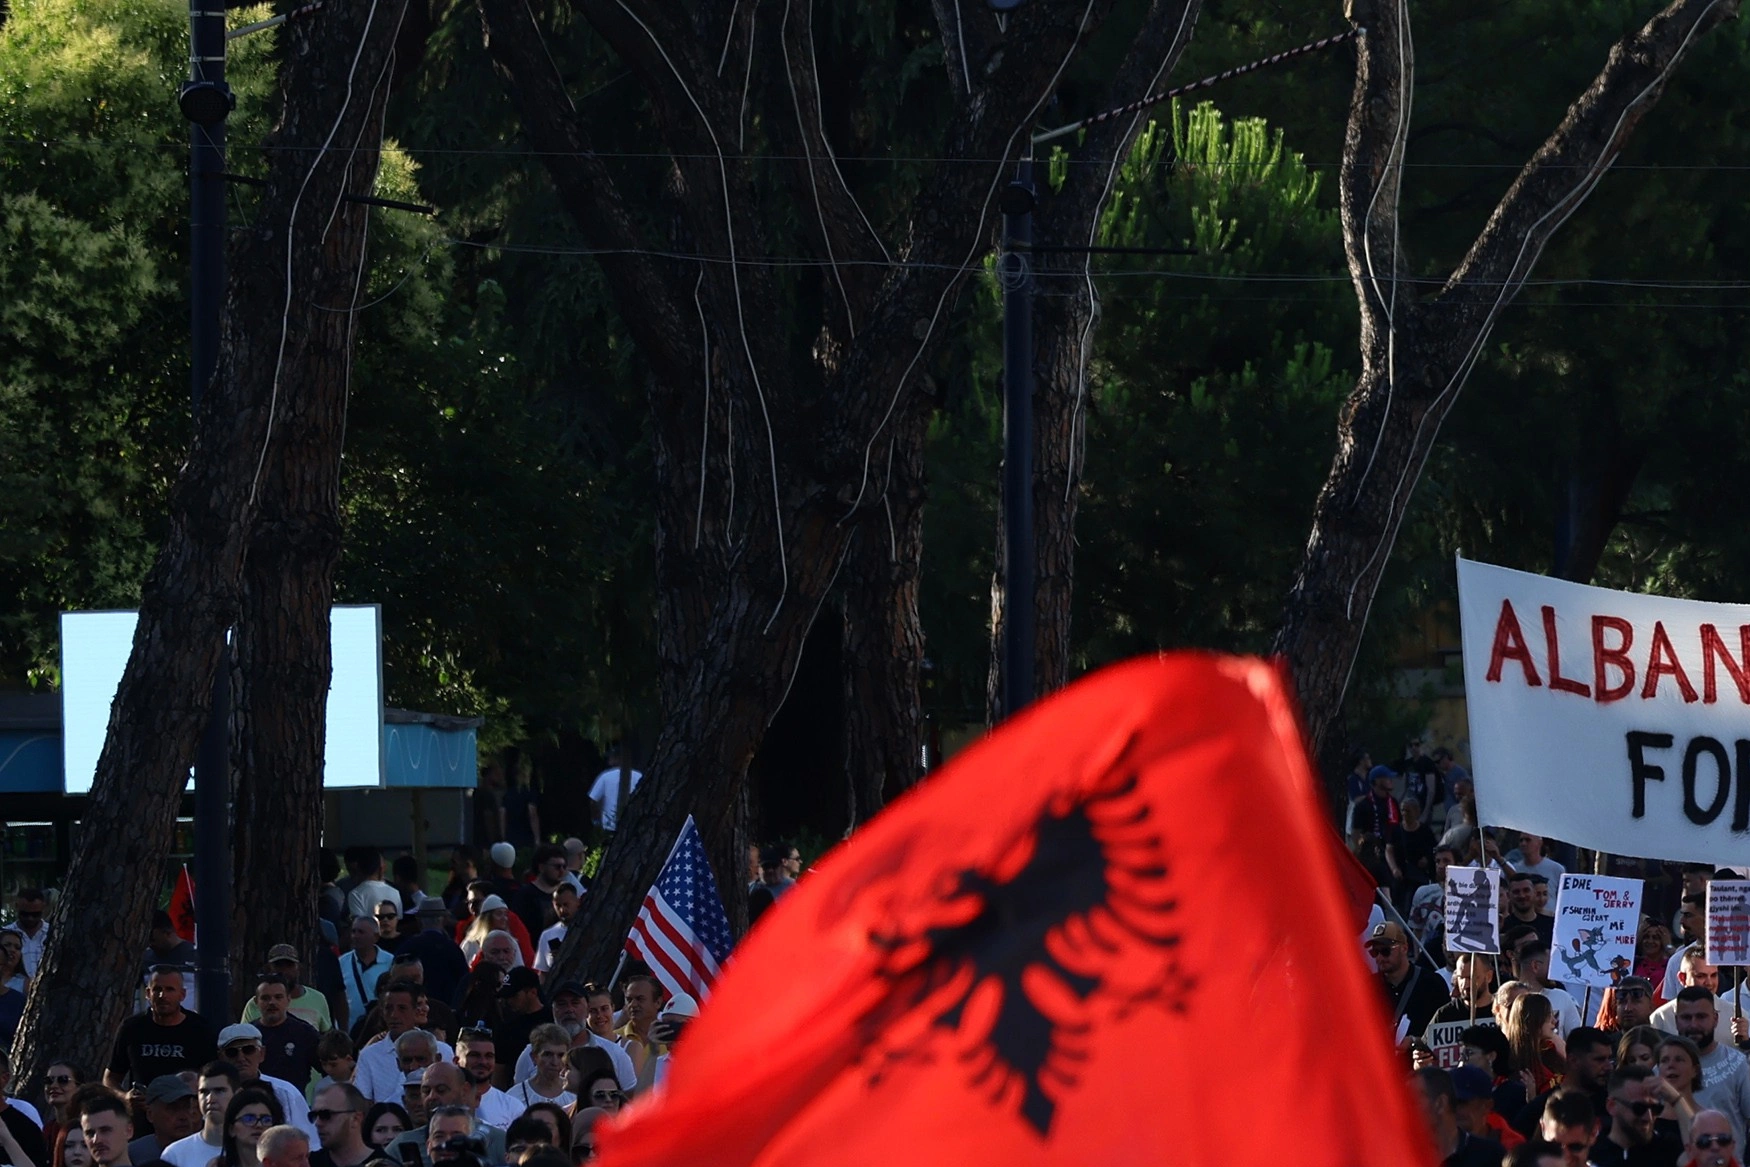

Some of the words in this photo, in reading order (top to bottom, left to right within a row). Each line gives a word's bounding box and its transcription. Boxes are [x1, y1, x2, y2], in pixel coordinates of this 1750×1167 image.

[1562, 877, 1592, 890] EDHE
[1593, 889, 1617, 900] TOM
[1623, 890, 1629, 901] &
[1603, 900, 1635, 909] JERRY
[1609, 920, 1625, 930] MË
[1615, 934, 1635, 945] MIRË
[141, 1044, 185, 1059] DIOR
[1439, 1047, 1460, 1068] FL
